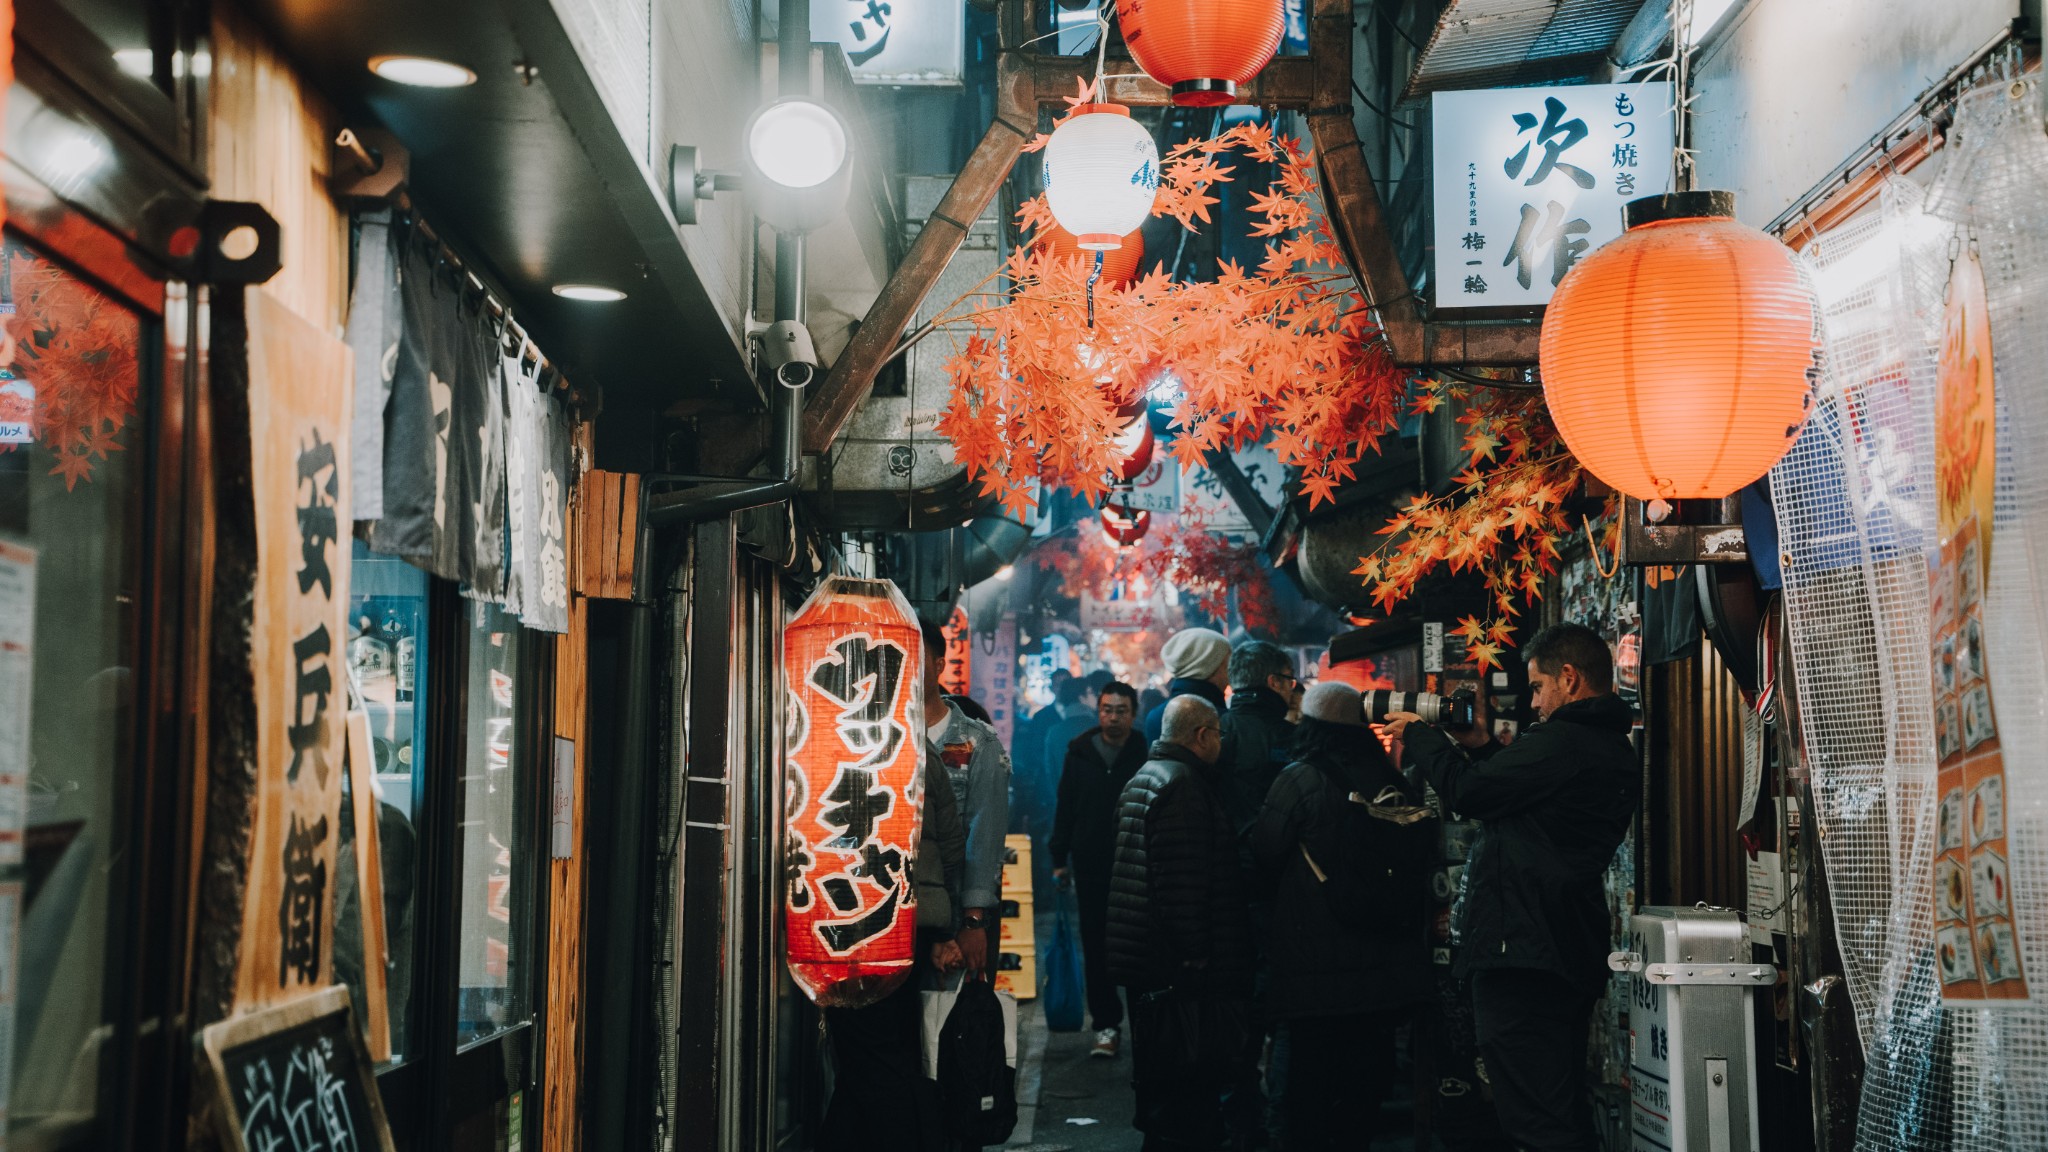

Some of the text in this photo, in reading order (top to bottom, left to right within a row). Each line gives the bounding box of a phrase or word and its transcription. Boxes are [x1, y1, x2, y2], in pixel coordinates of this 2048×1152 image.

[1612, 93, 1638, 196] もつ焼き
[1468, 162, 1478, 226] 九十九里の地酒
[1503, 96, 1596, 291] 次作
[1461, 231, 1488, 295] 梅一輪
[1633, 974, 1659, 1013] やきとり
